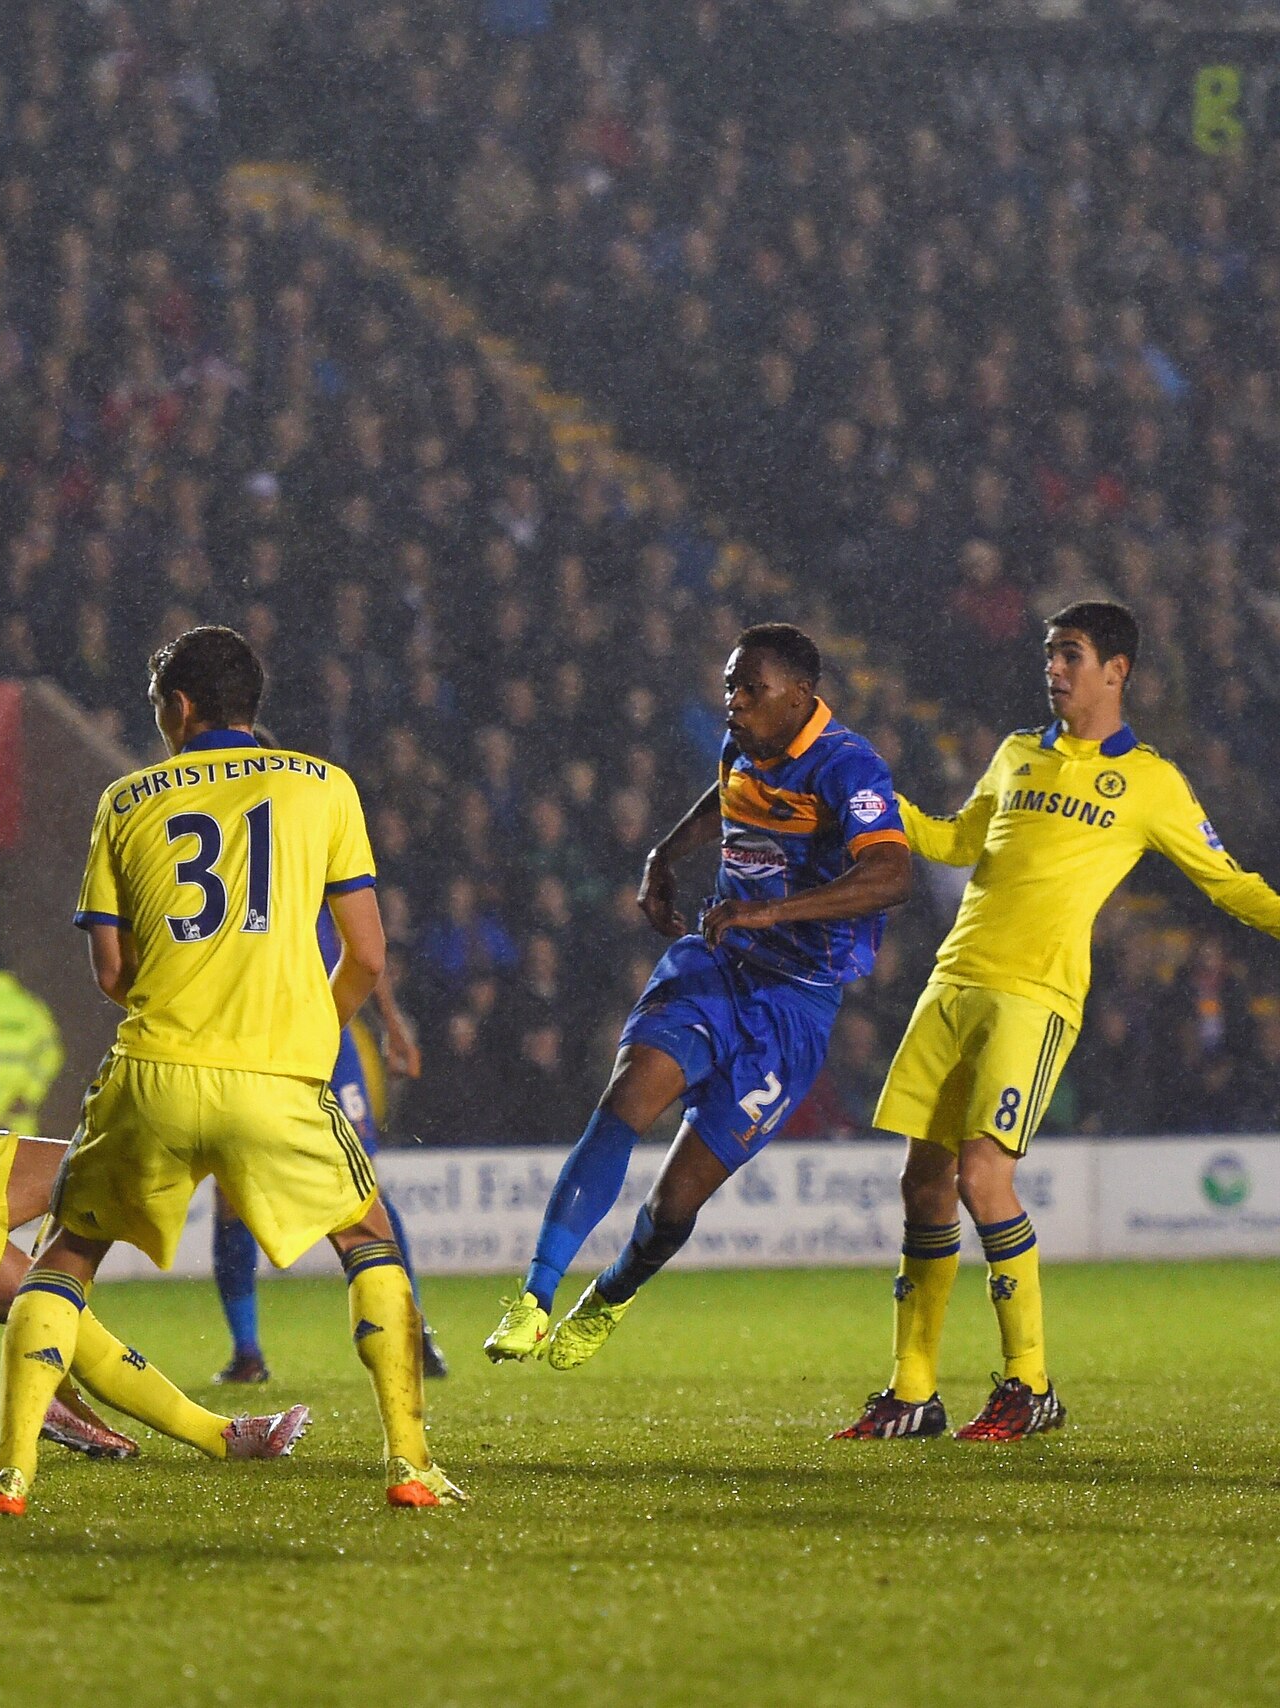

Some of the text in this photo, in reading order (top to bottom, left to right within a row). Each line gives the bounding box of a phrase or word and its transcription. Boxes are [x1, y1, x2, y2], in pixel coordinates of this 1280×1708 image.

[112, 756, 328, 816] CHRISTENSEN
[164, 797, 272, 944] 31
[993, 1086, 1022, 1133] 8
